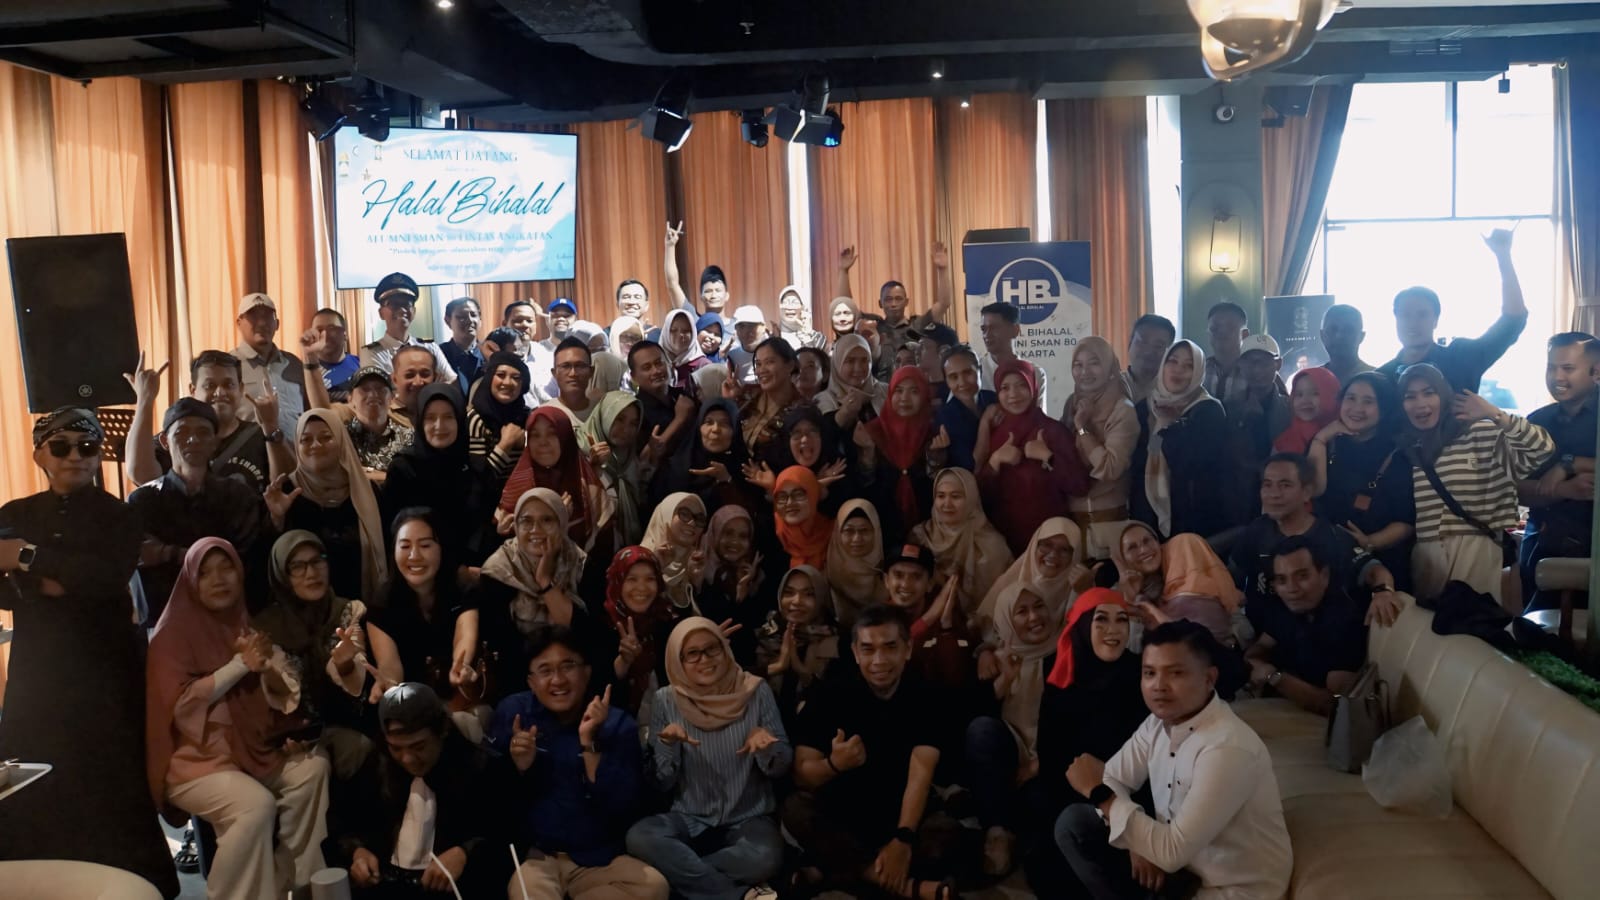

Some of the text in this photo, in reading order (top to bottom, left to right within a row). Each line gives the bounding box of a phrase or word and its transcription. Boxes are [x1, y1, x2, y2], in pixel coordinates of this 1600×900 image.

[362, 176, 565, 230] Halal Bihalal
[1002, 279, 1052, 305] HB
[1027, 327, 1072, 336] BIHALAL
[1030, 339, 1061, 347] SMAN
[1064, 338, 1076, 346] 80
[1016, 349, 1056, 359] KARTA
